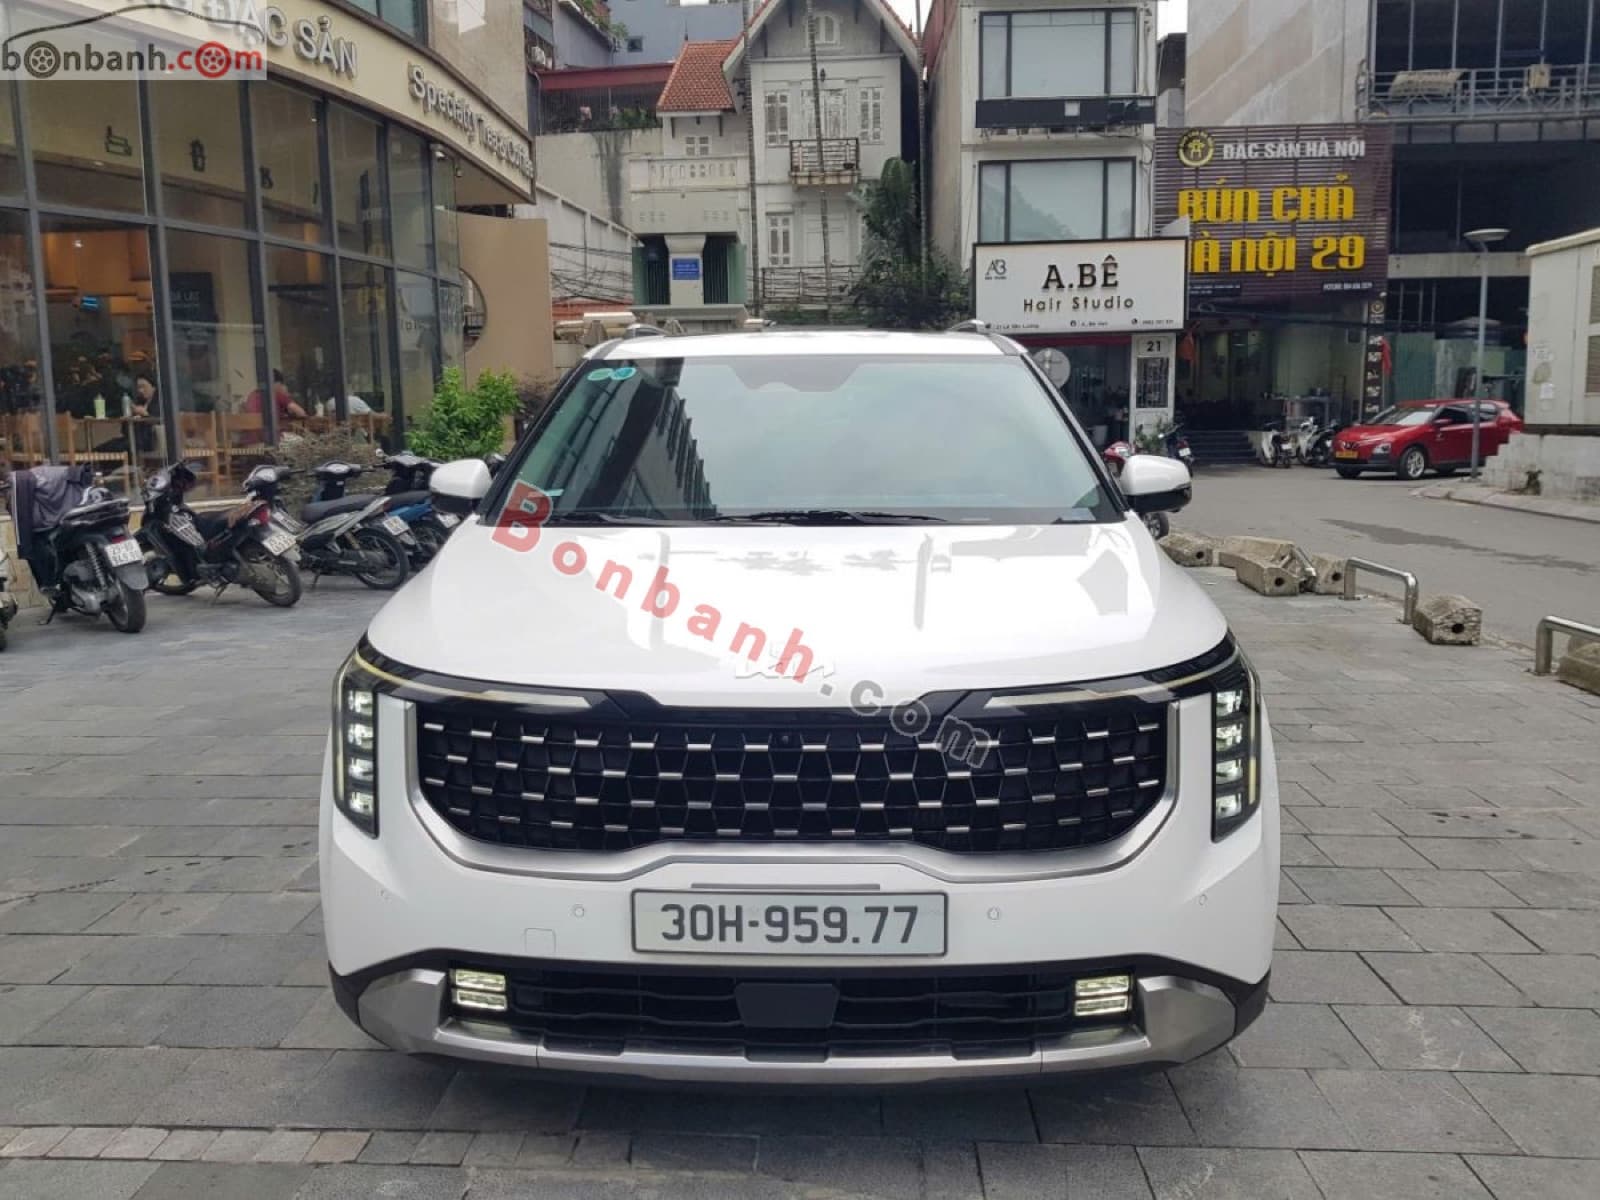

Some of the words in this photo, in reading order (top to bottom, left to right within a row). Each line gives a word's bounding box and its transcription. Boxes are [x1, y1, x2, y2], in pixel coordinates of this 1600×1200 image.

[1311, 235, 1366, 271] 29
[1042, 253, 1119, 290] A.BÊ
[1023, 298, 1062, 313] Hair
[1072, 296, 1135, 311] Studio
[1146, 340, 1162, 352] 21
[660, 903, 919, 944] 30H-959.77
